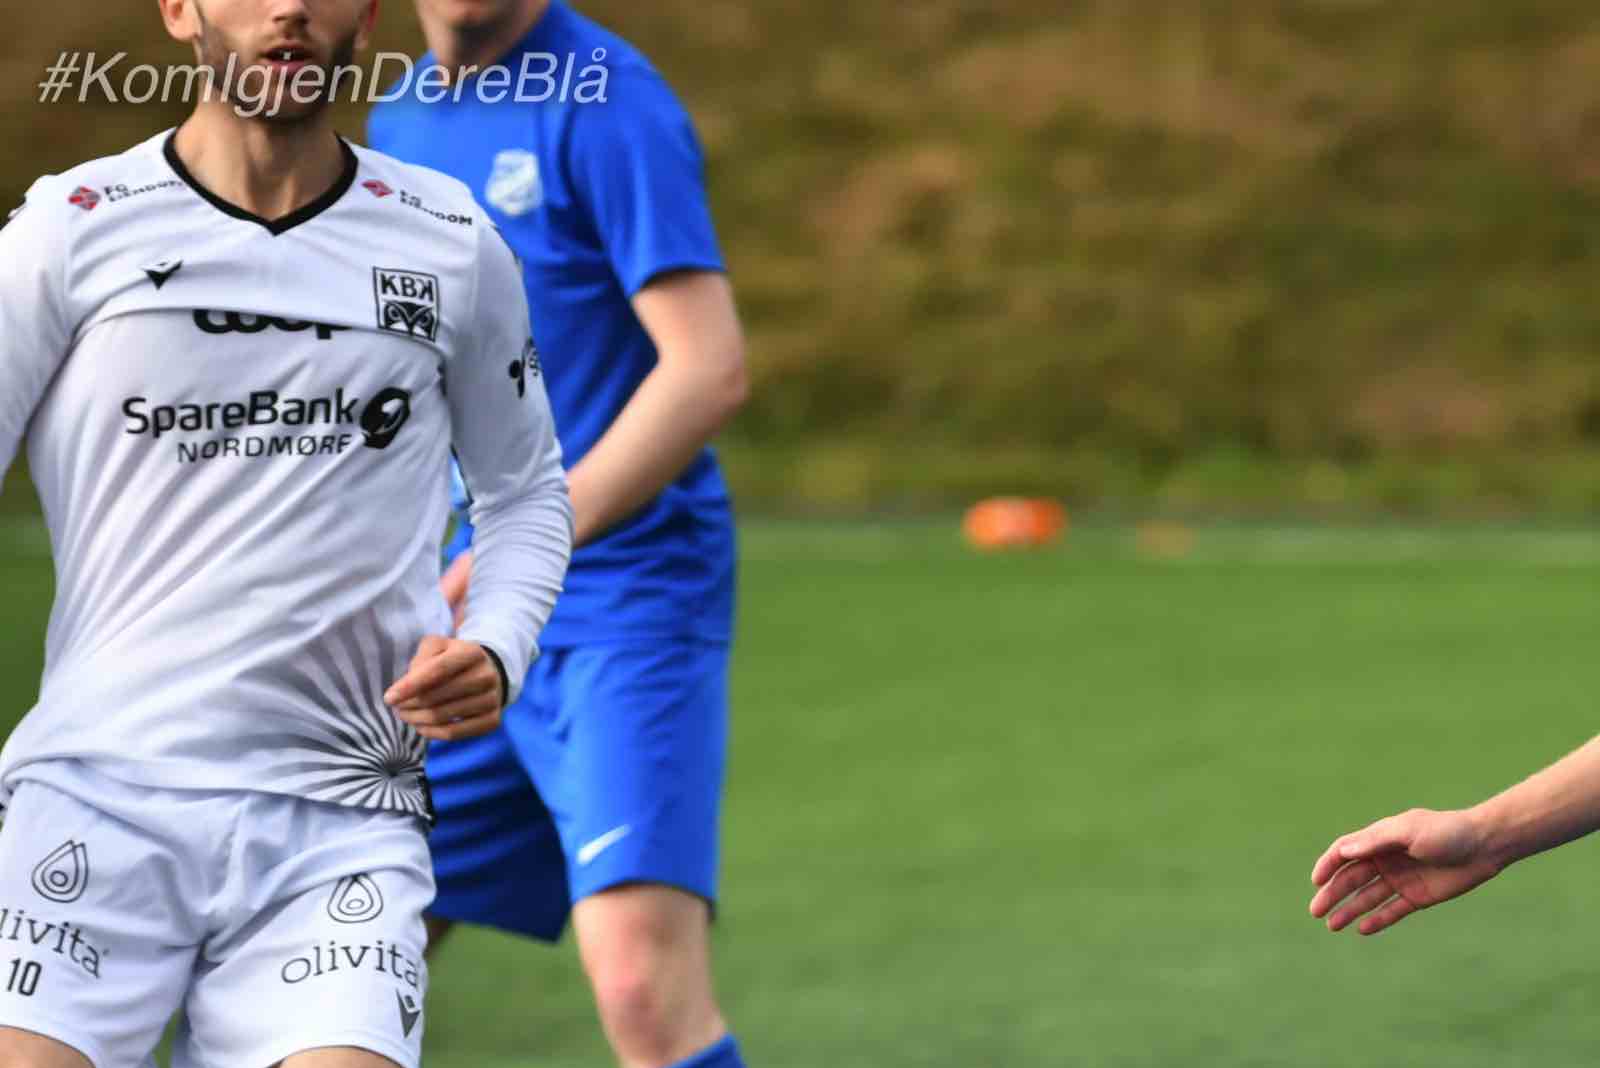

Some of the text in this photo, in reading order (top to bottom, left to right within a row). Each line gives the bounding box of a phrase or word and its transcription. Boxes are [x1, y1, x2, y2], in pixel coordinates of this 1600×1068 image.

[121, 388, 361, 439] SpareBank
[0, 908, 101, 979] livita
[281, 940, 418, 988] olivita
[7, 957, 42, 996] 10
